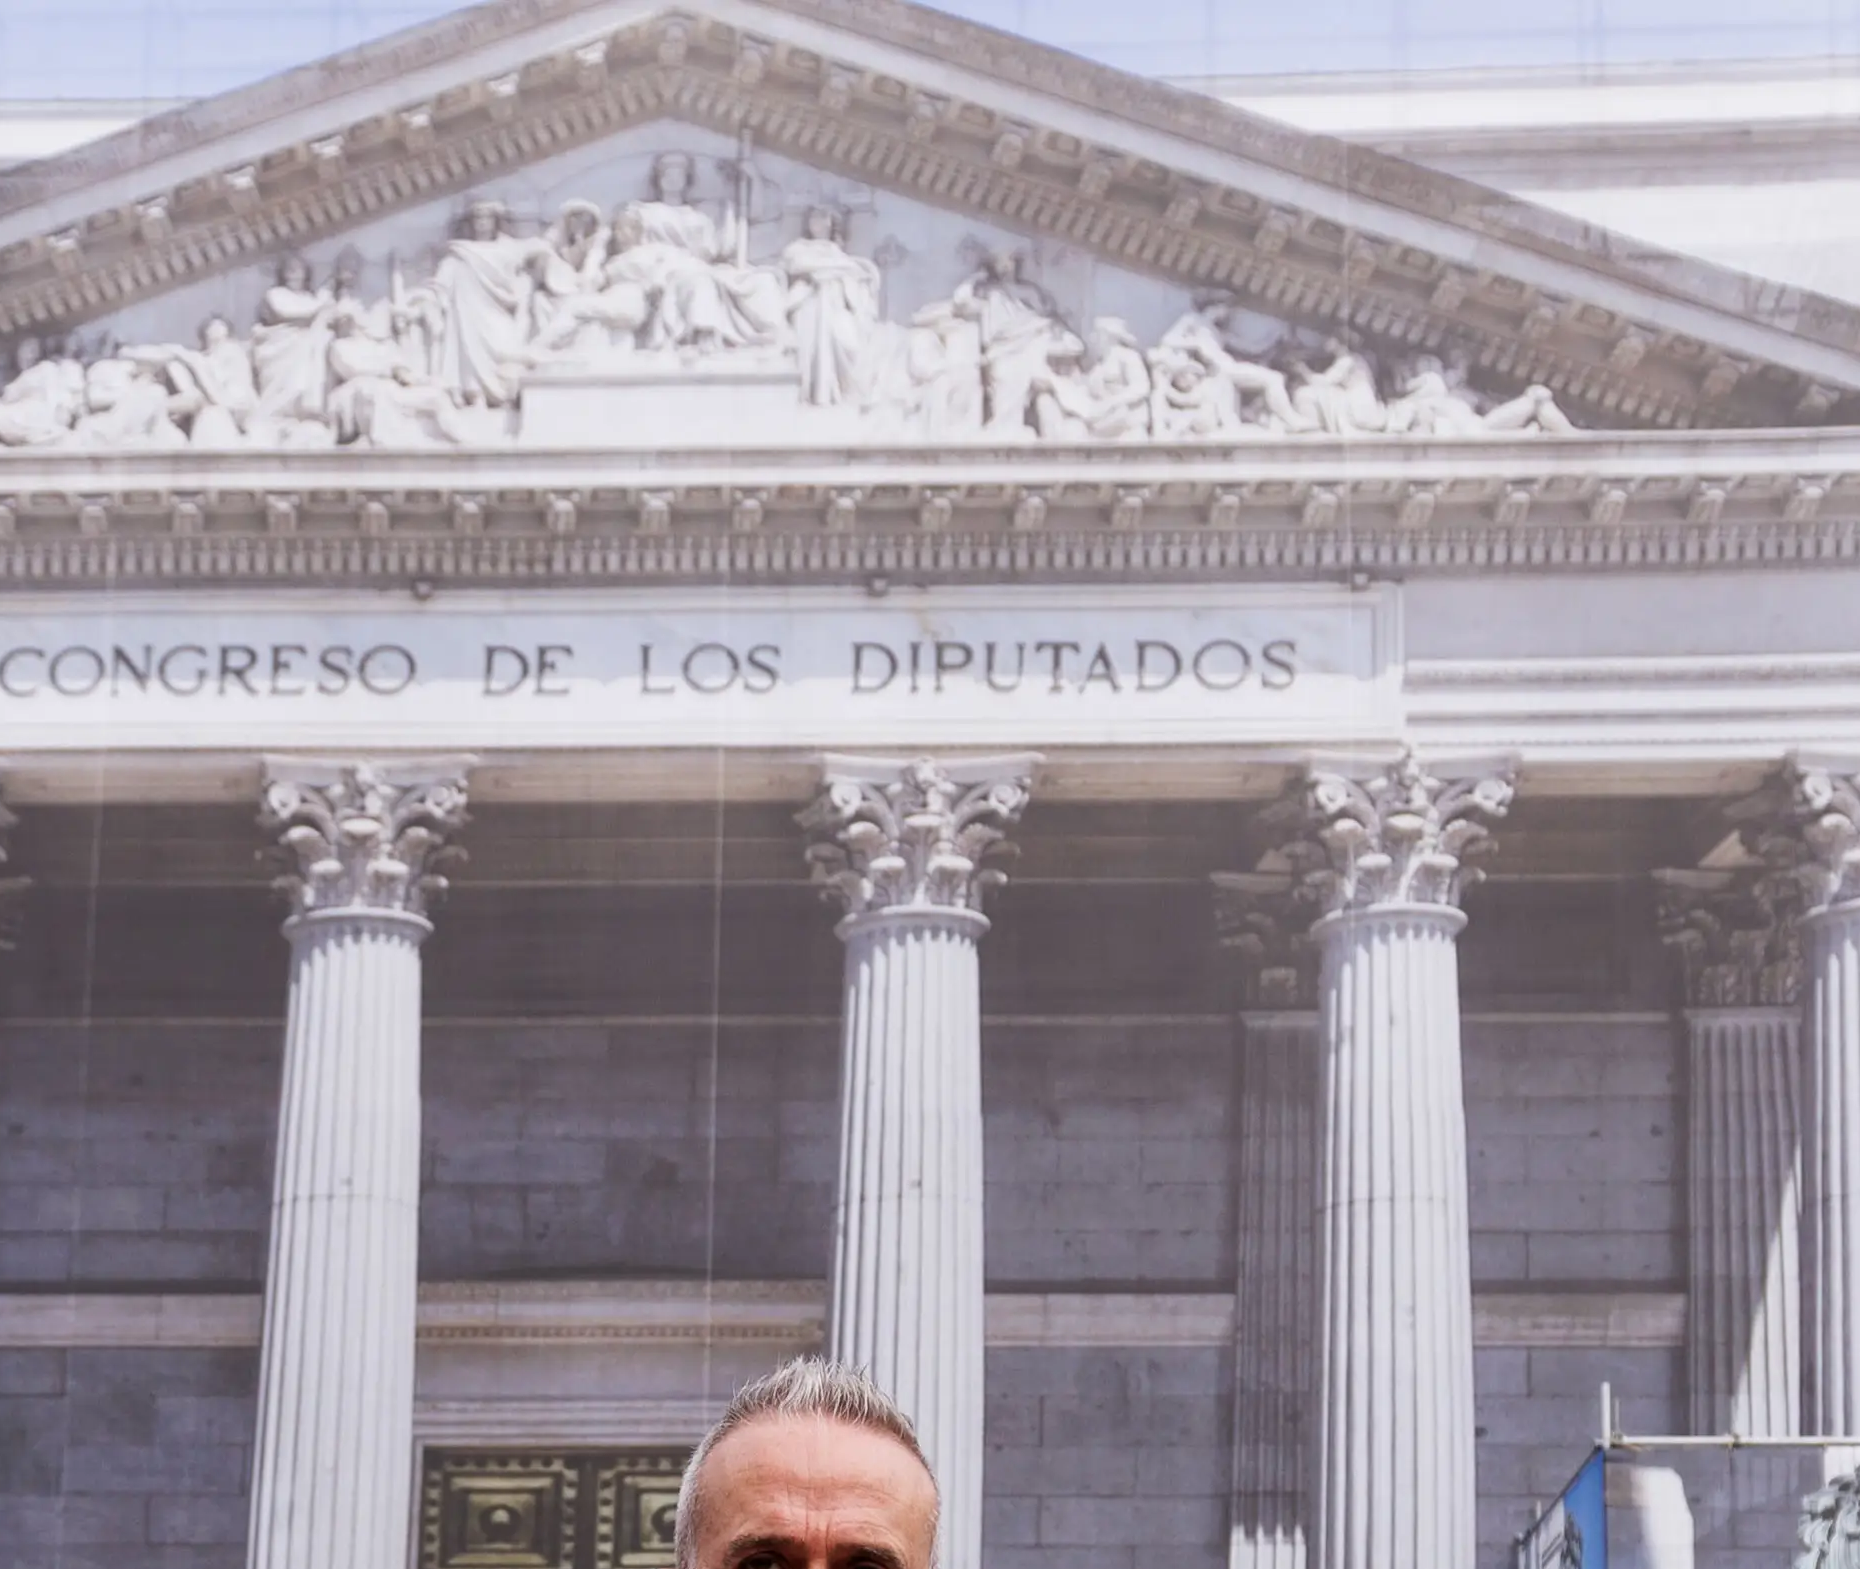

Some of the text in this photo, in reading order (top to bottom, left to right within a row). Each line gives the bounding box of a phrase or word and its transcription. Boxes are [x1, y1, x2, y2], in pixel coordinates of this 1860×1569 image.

[481, 643, 574, 698] DE
[640, 641, 781, 697] LOS
[850, 639, 1300, 696] DIPUTADOS
